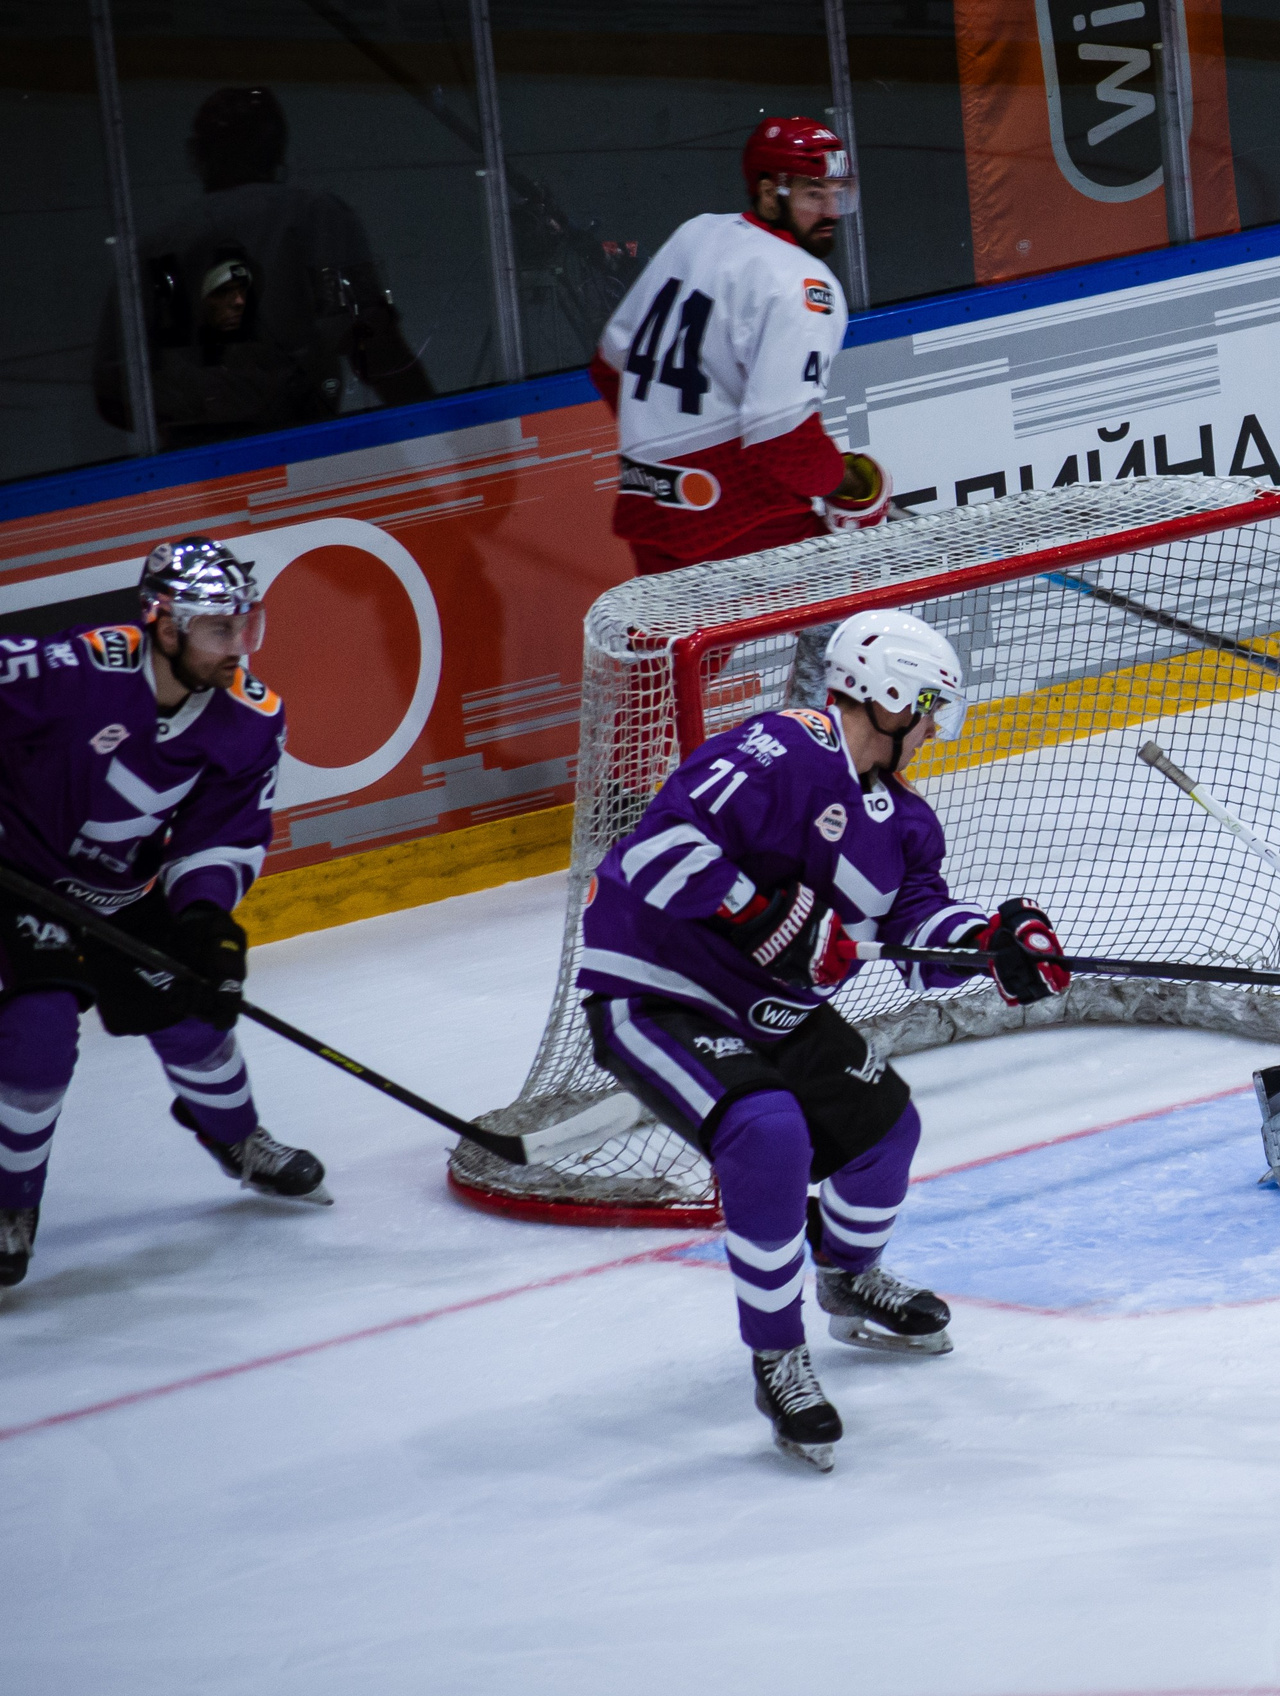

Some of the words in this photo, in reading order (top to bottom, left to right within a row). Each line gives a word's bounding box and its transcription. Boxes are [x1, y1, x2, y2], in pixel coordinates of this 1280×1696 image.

[624, 277, 714, 415] 44
[689, 758, 749, 815] 71
[867, 798, 888, 812] 10
